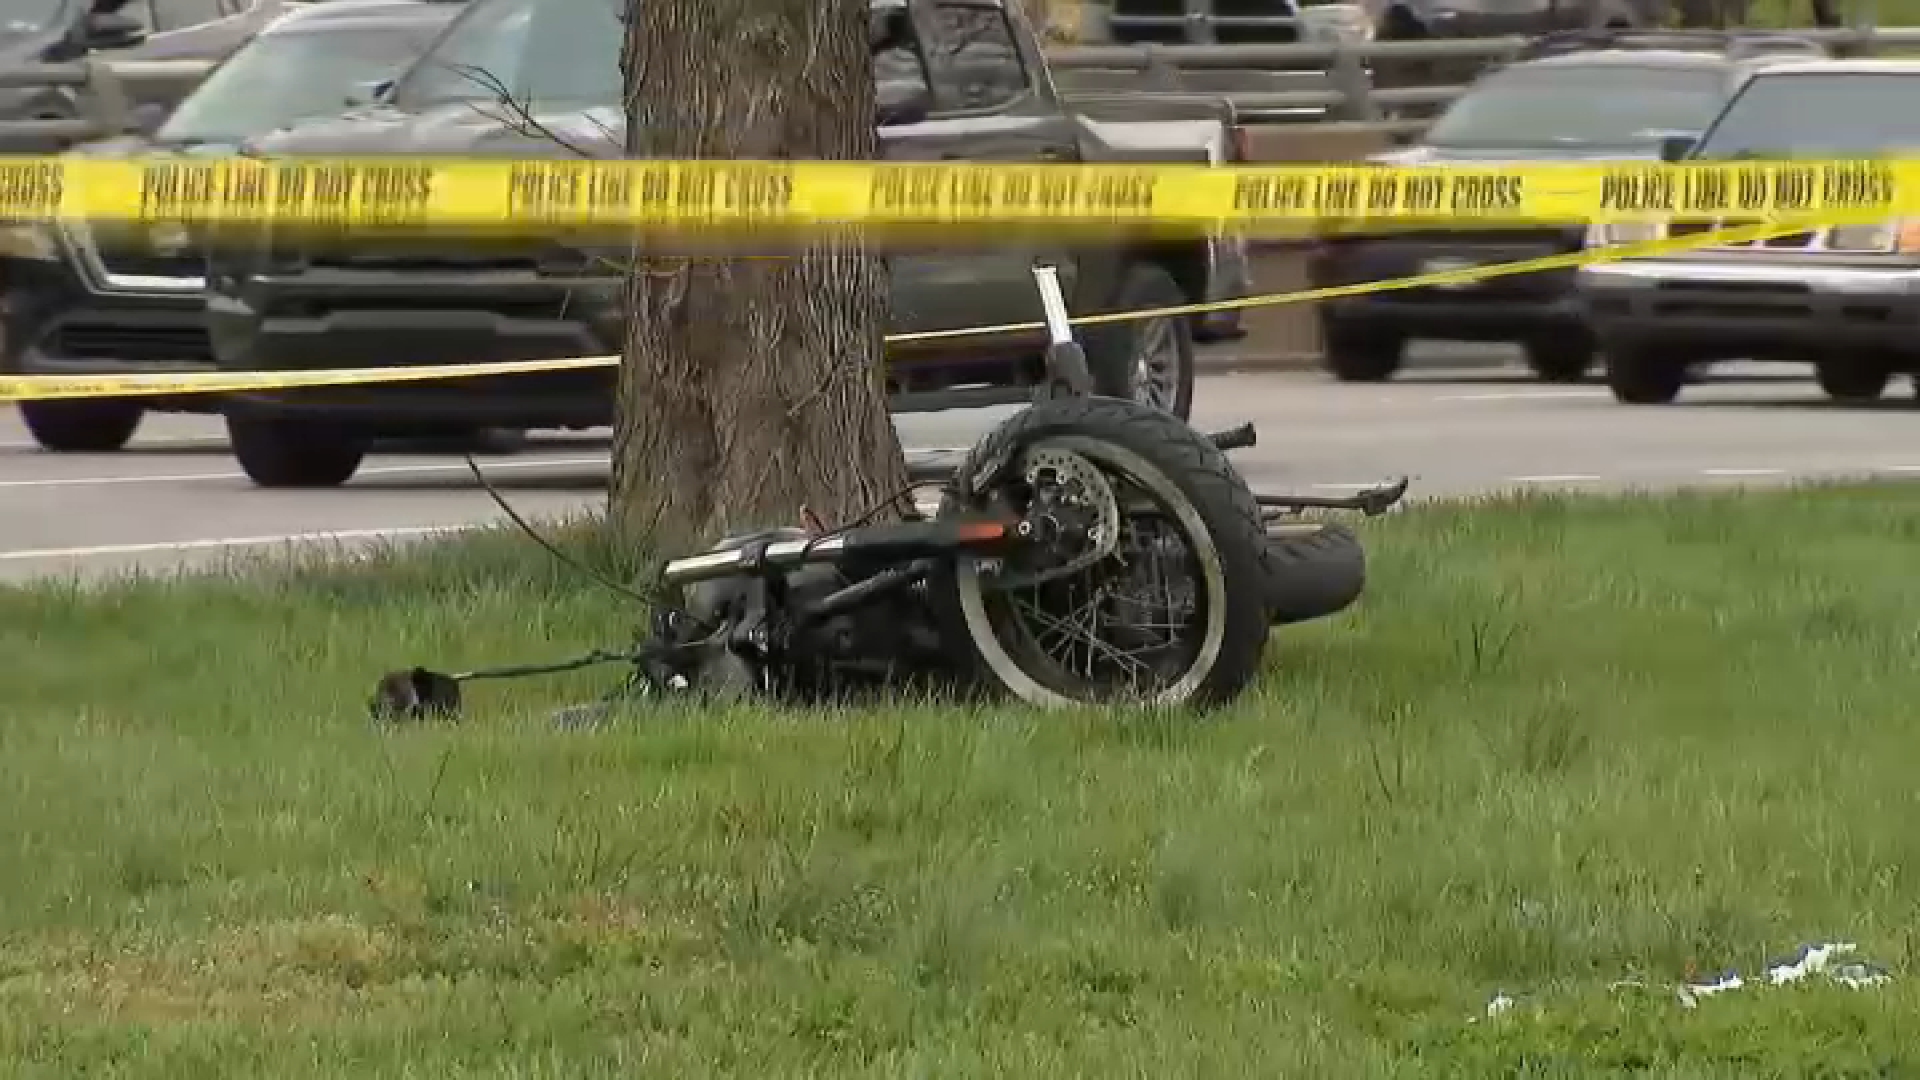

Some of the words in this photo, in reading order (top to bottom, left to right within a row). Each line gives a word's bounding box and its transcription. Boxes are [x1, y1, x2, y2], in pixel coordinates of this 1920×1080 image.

[140, 166, 215, 209] POLICE
[277, 166, 306, 209] DO
[314, 166, 352, 209] NOT
[362, 166, 431, 209] CROSS
[508, 167, 577, 211] POLICE
[642, 167, 671, 211] DO
[677, 167, 717, 211] NOT
[725, 167, 793, 211] CROSS
[870, 167, 940, 211] POLICE
[1001, 167, 1034, 211] DO
[1040, 167, 1076, 211] NOT
[1234, 172, 1306, 211] POLICE
[1314, 172, 1358, 211] LINE
[1367, 172, 1398, 211] DO
[1403, 172, 1443, 211] NOT
[1450, 172, 1522, 211] CROSS
[1601, 168, 1675, 210] POLICE
[1684, 168, 1728, 210] LINE
[1738, 168, 1767, 210] DO
[1774, 168, 1814, 210] NOT
[1822, 168, 1893, 210] CROSS
